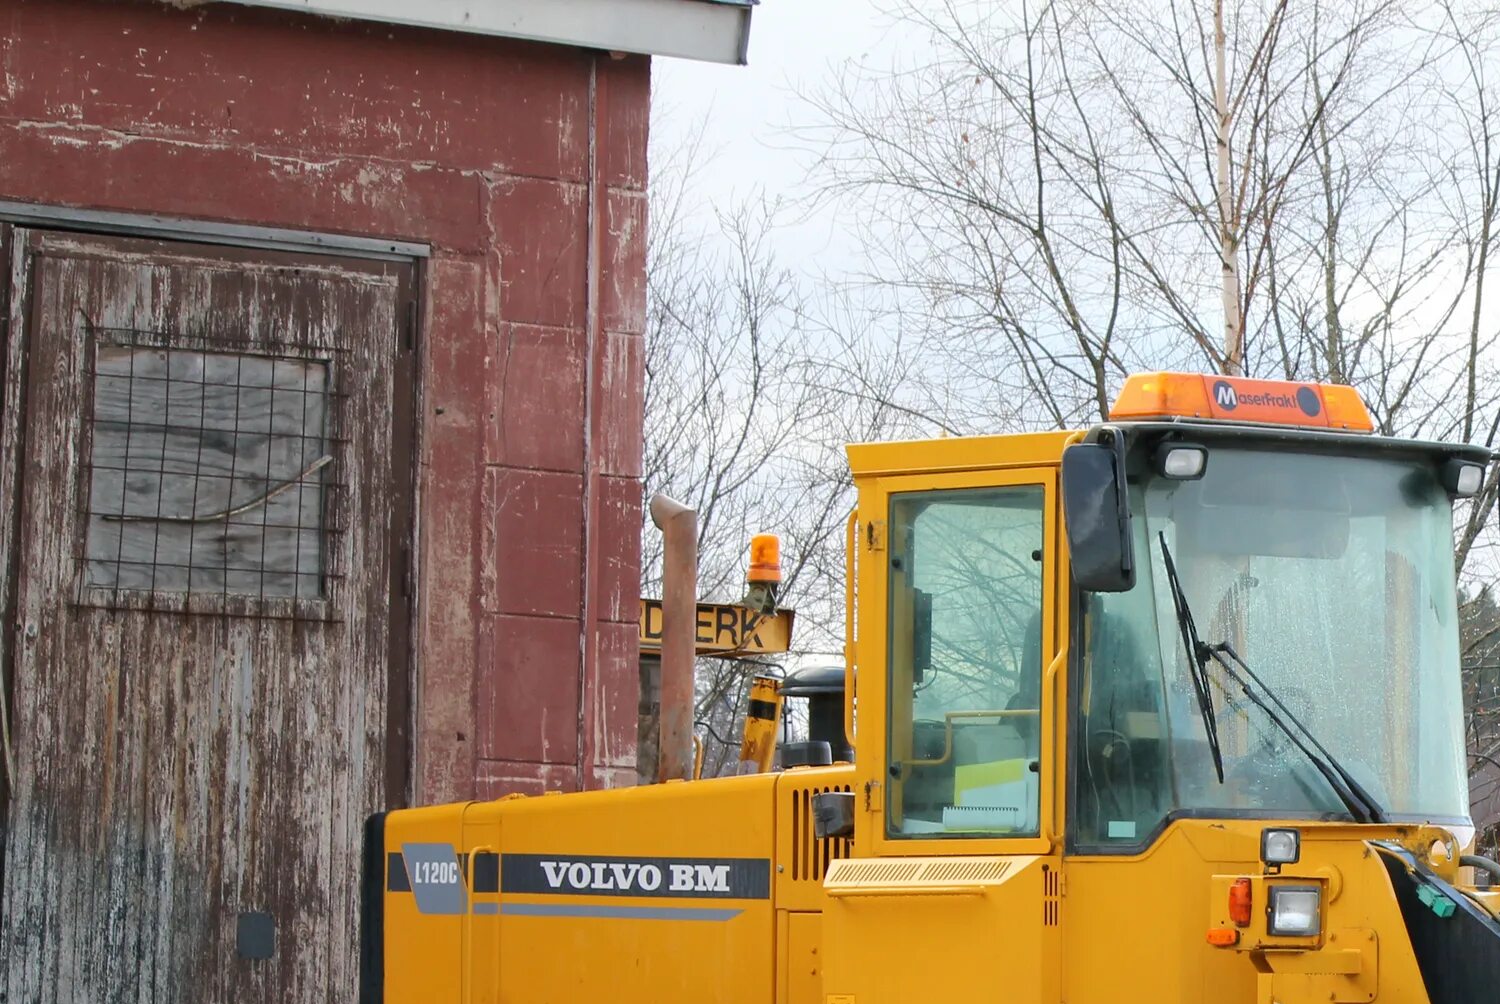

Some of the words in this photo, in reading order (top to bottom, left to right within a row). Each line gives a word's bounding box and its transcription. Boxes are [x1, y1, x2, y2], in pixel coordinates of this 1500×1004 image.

[415, 862, 457, 884] L120C
[540, 861, 662, 891] VOLVO
[669, 865, 730, 892] BM
